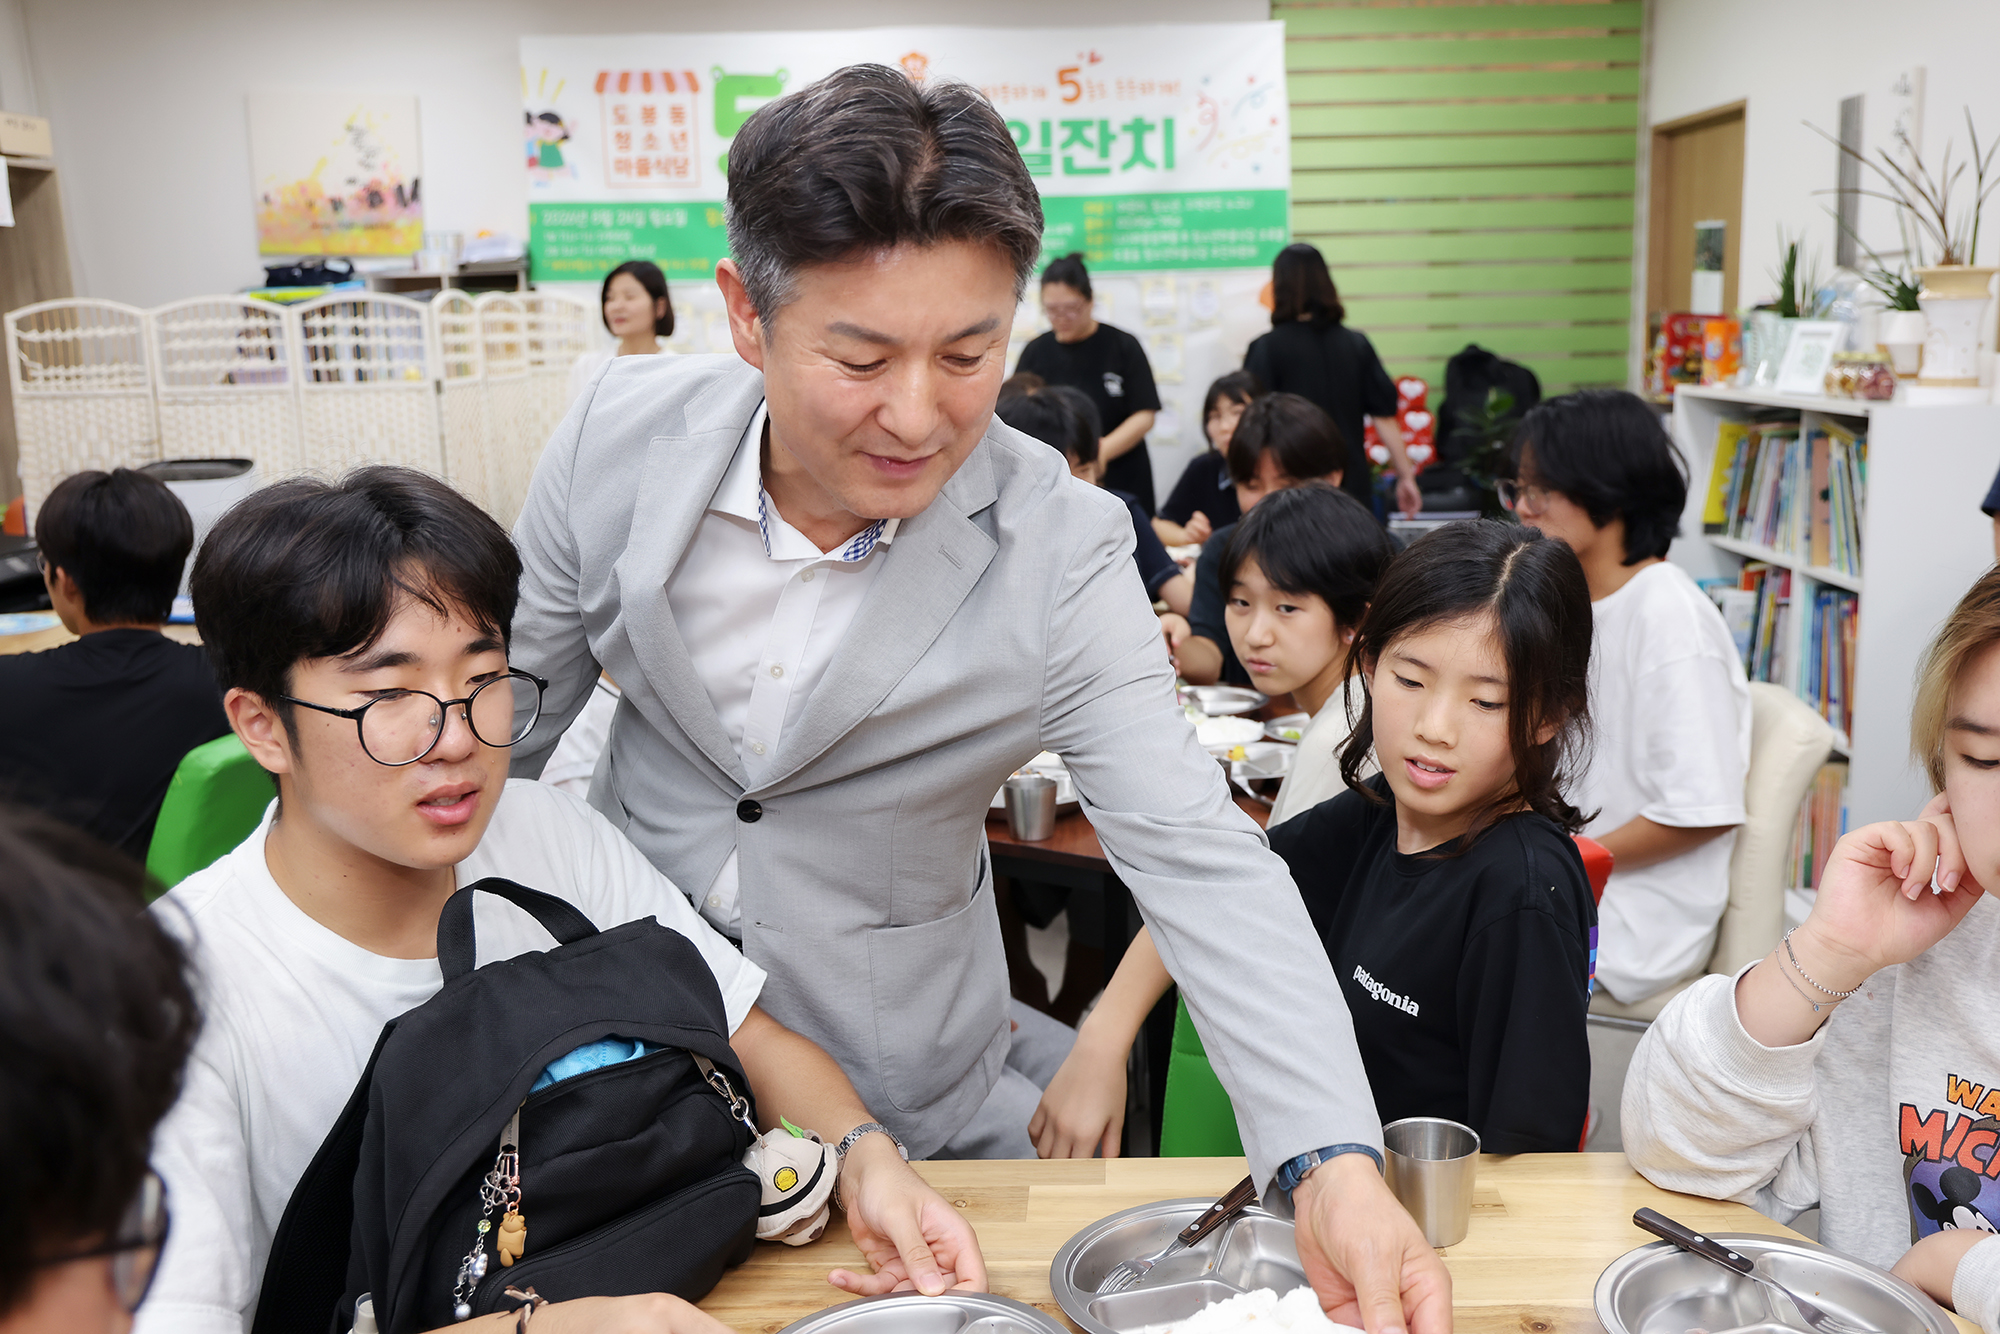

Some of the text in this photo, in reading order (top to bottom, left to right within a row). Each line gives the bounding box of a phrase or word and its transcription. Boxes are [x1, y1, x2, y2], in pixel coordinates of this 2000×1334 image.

[612, 104, 687, 127] 도봉동
[613, 130, 689, 153] 청소년
[613, 156, 691, 178] 마을식당
[1352, 964, 1421, 1018] patagonia
